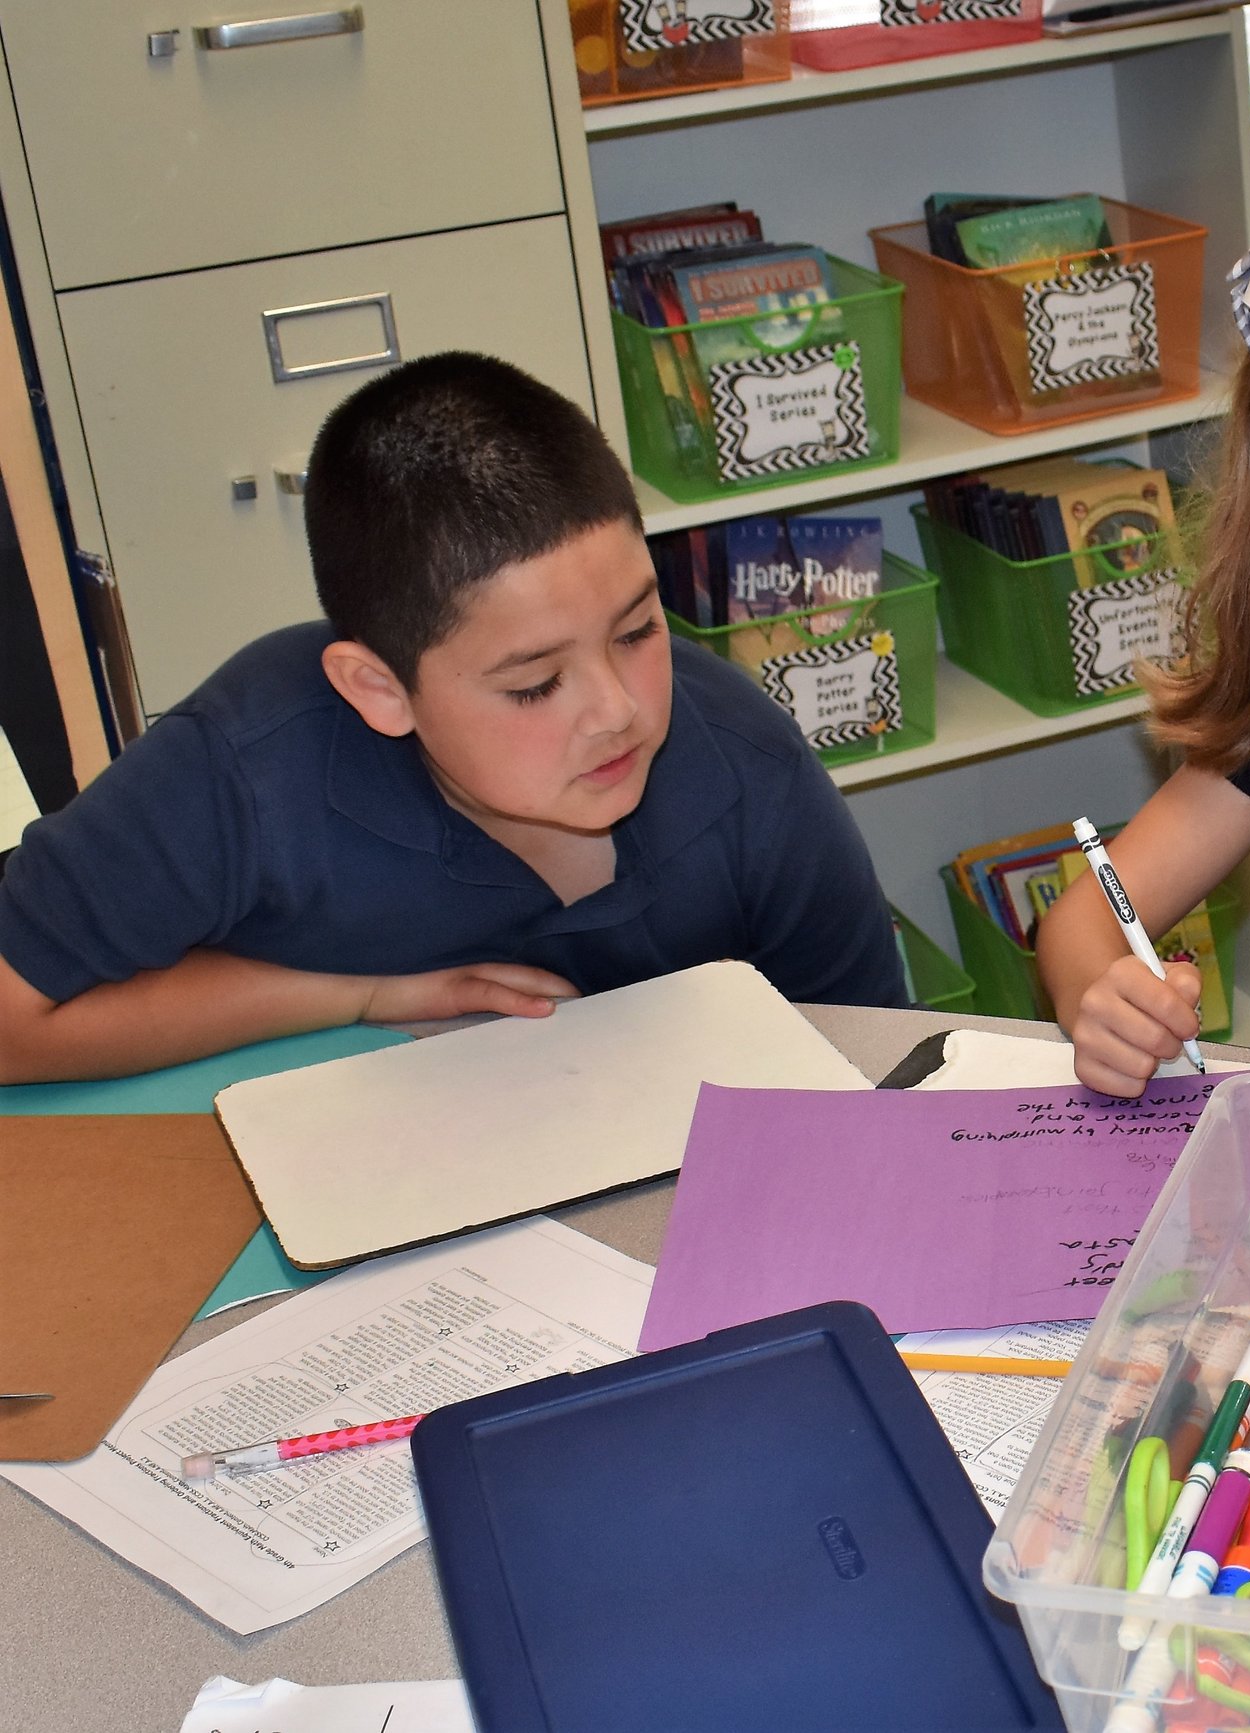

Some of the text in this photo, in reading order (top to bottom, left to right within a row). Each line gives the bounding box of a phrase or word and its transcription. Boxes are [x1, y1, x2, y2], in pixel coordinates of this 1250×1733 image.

[628, 221, 750, 254] SURVIVED
[689, 258, 821, 303] I SURVIVED
[756, 384, 828, 409] I Survived
[770, 404, 817, 423] Series
[732, 557, 880, 602] Harry Potter
[1118, 618, 1159, 636] Events
[1119, 634, 1160, 650] Series
[816, 687, 856, 701] Potter
[817, 702, 858, 718] Series
[1102, 868, 1134, 920] Crayola
[1016, 1101, 1056, 1112] the
[949, 1125, 1066, 1146] multiplying
[1071, 1123, 1094, 1136] by
[1058, 1237, 1135, 1249] asta
[1063, 1276, 1116, 1286] eet
[1016, 1330, 1036, 1338] should
[1014, 1343, 1043, 1354] Important
[1000, 1379, 1023, 1388] fractions
[1034, 1384, 1057, 1392] greatest
[1000, 1396, 1023, 1406] fractions
[1016, 1396, 1039, 1405] fractions
[1020, 1391, 1046, 1401] gathered
[948, 1403, 976, 1413] daughters
[1000, 1408, 1022, 1417] females
[1009, 1406, 1028, 1414] Create
[953, 1411, 970, 1419] family
[947, 1421, 993, 1439] immediate family
[964, 1421, 988, 1431] amounts
[980, 1421, 1004, 1430] example
[970, 1437, 987, 1445] males
[118, 1452, 137, 1464] Project
[134, 1463, 160, 1480] Fractions
[985, 1472, 1016, 1486] Due Date
[159, 1479, 184, 1496] Ordering
[984, 1496, 1005, 1506] tions
[194, 1503, 221, 1521] Fractions
[219, 1520, 251, 1540] Equivalent
[249, 1539, 266, 1549] Math
[265, 1548, 284, 1561] Grade
[283, 1560, 294, 1568] 4th
